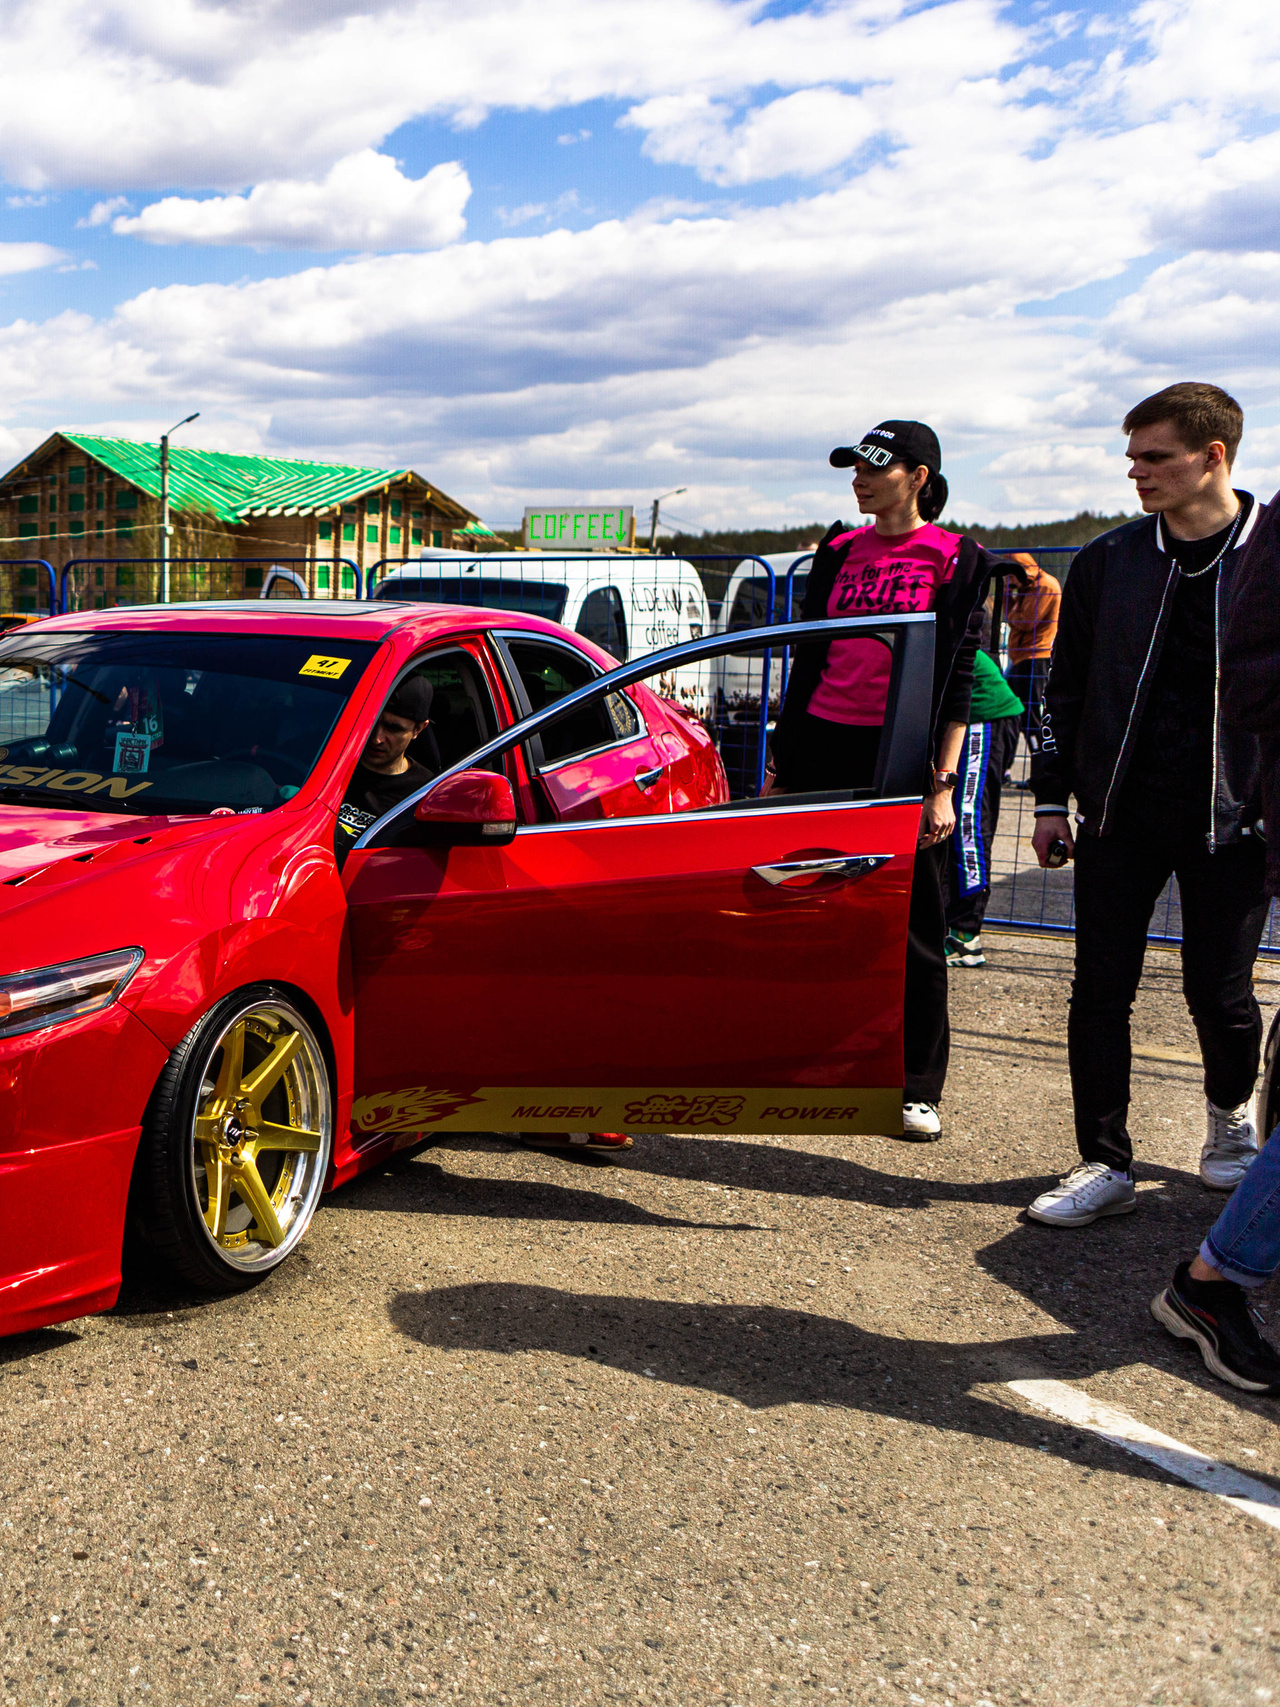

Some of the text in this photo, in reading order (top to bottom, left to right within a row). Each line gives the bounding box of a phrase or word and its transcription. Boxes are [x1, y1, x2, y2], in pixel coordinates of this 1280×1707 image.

[530, 514, 614, 540] COFFEE
[861, 564, 883, 581] for
[888, 561, 914, 577] the
[836, 575, 926, 611] DRIFT
[511, 1105, 603, 1118] MUGEN
[759, 1106, 860, 1120] POWER
